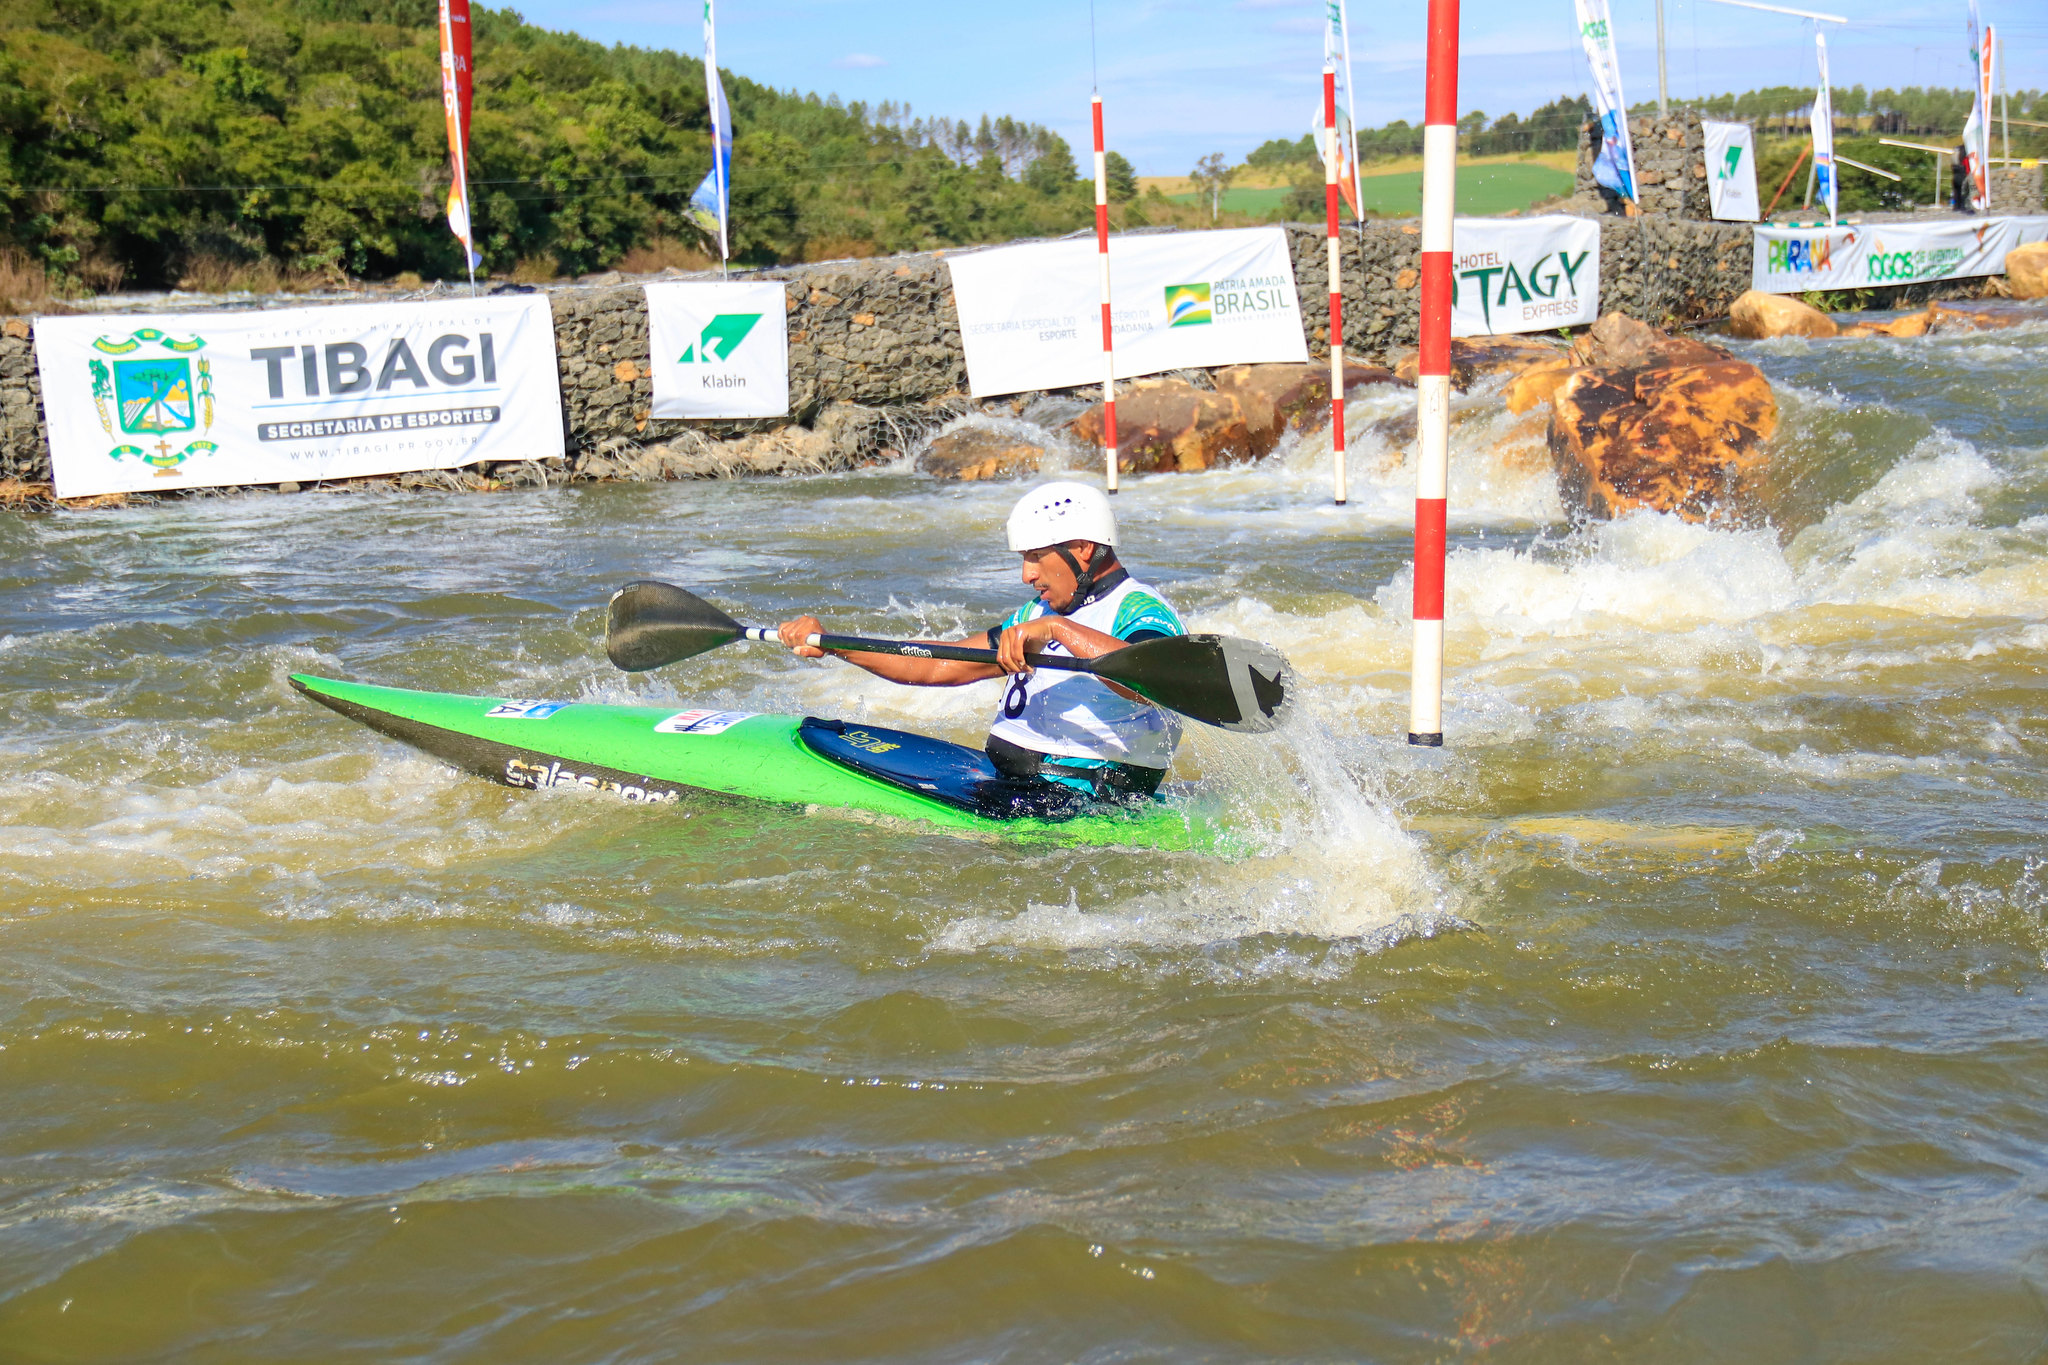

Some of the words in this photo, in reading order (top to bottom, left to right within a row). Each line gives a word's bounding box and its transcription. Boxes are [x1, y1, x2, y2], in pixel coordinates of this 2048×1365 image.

[1460, 252, 1503, 269] HOTEL
[1249, 275, 1286, 287] AMADA
[1213, 289, 1290, 315] BRASIL
[1522, 300, 1579, 320] EXPRESS
[1022, 318, 1062, 331] ESPECIAL
[1110, 322, 1155, 335] IDADANIA
[1039, 329, 1078, 341] ESPORTE
[250, 333, 497, 399] TIBAGI
[702, 374, 747, 389] Klabin
[267, 418, 376, 439] SECRETARIA
[380, 415, 404, 432] DE
[407, 408, 494, 428] ESPORTES
